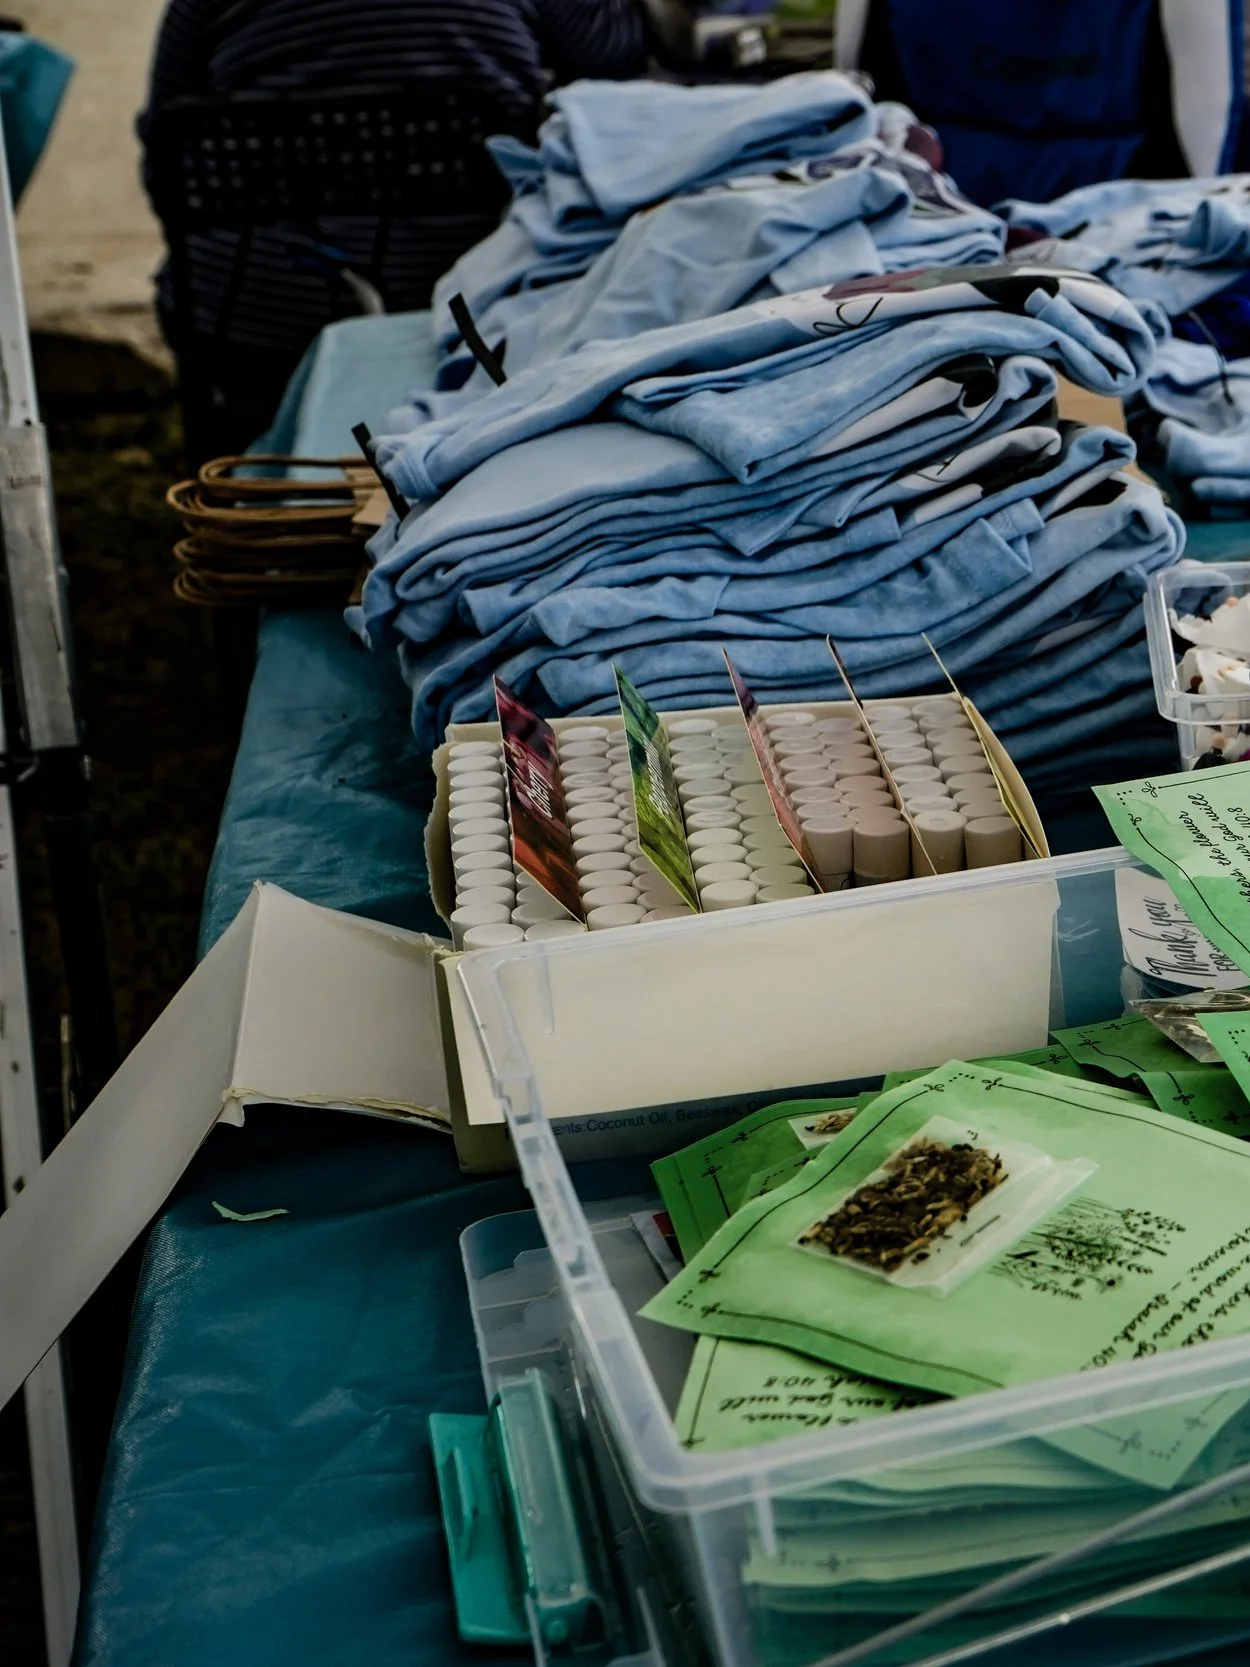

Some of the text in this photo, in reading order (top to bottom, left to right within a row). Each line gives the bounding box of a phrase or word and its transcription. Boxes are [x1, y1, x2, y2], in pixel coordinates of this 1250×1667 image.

[1188, 794, 1219, 821] will
[1179, 811, 1219, 846] flower
[1212, 823, 1243, 841] God
[1210, 848, 1231, 866] the
[1128, 928, 1217, 976] Thank
[649, 1111, 673, 1125] Oil,
[1200, 1267, 1240, 1296] word
[1183, 1298, 1200, 1312] of
[1153, 1314, 1182, 1339] our
[1182, 1323, 1214, 1346] the
[763, 1377, 816, 1389] 40:8
[720, 1395, 780, 1412] will
[743, 1413, 832, 1427] flower
